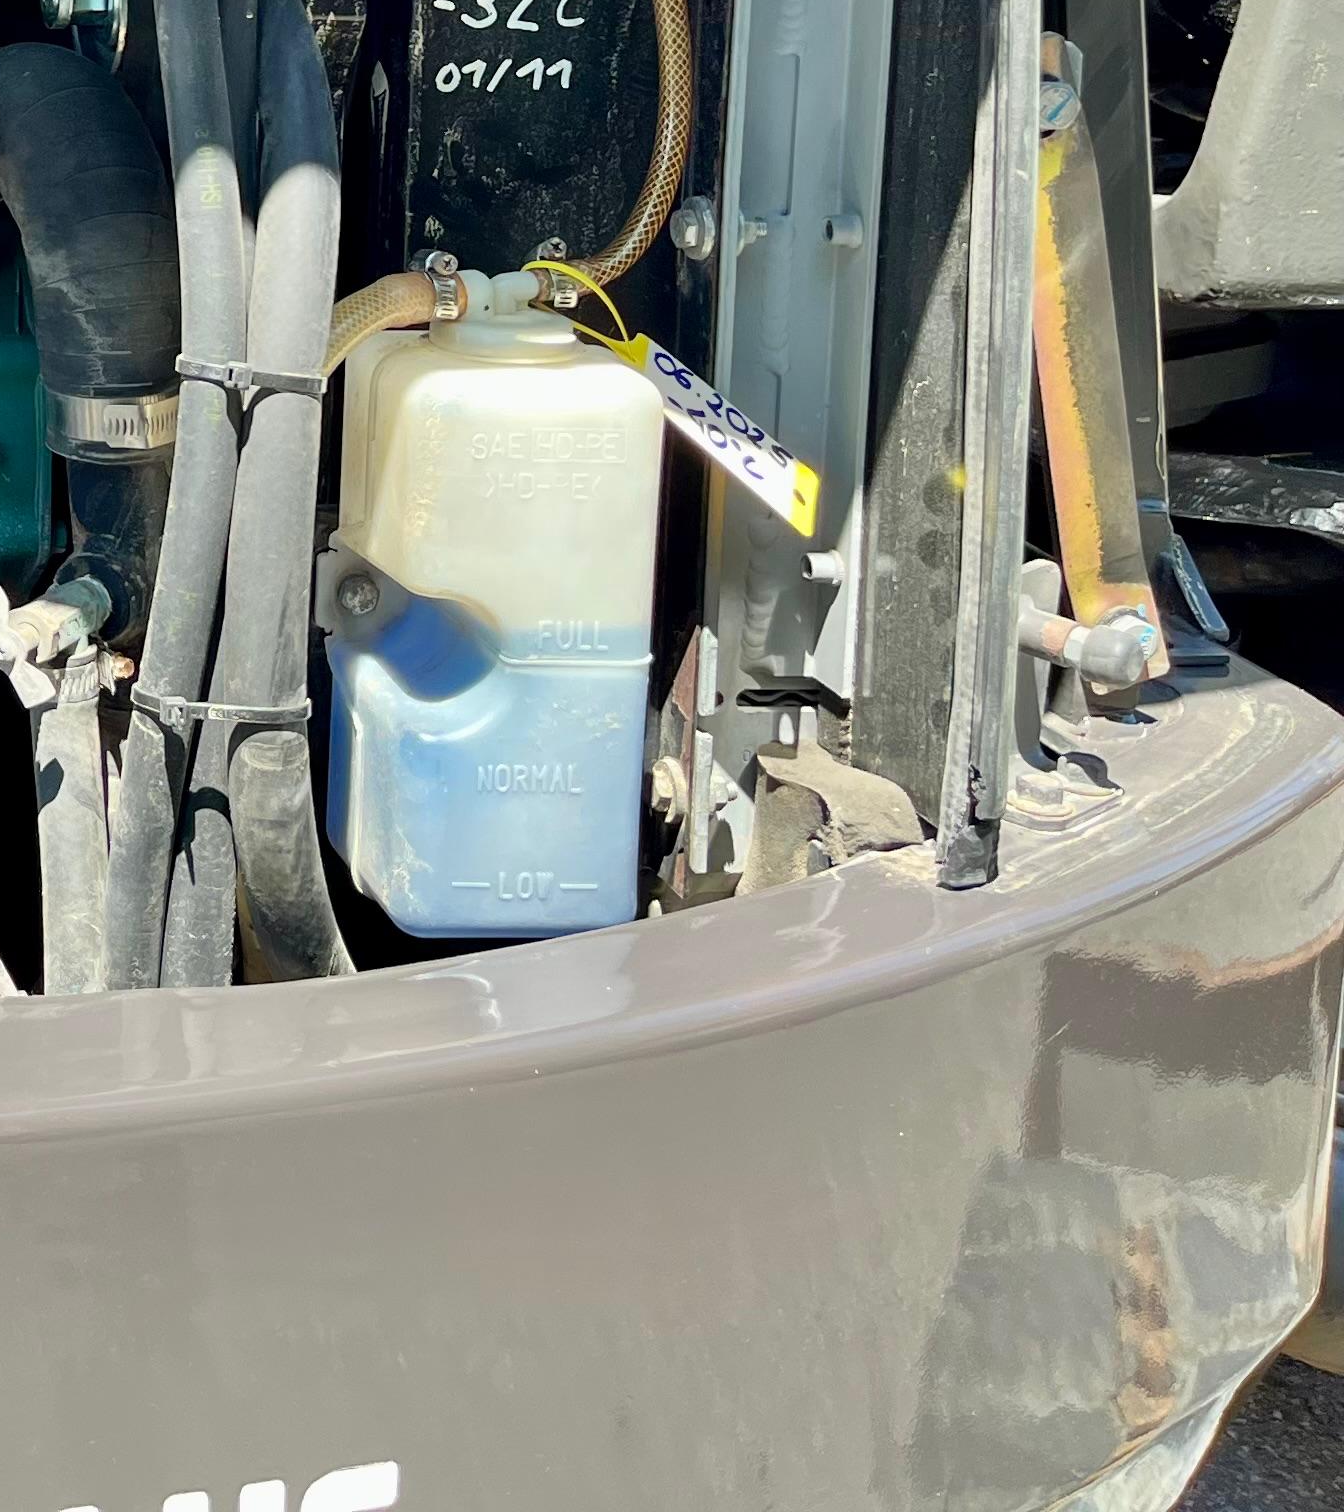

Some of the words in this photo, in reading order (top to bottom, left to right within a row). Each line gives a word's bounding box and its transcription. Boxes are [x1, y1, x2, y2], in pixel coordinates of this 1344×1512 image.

[435, 57, 572, 93] 01/11
[471, 433, 527, 460] SAE
[537, 619, 608, 651] FULL
[477, 763, 584, 794] NORMAL
[498, 871, 555, 900] LOW
